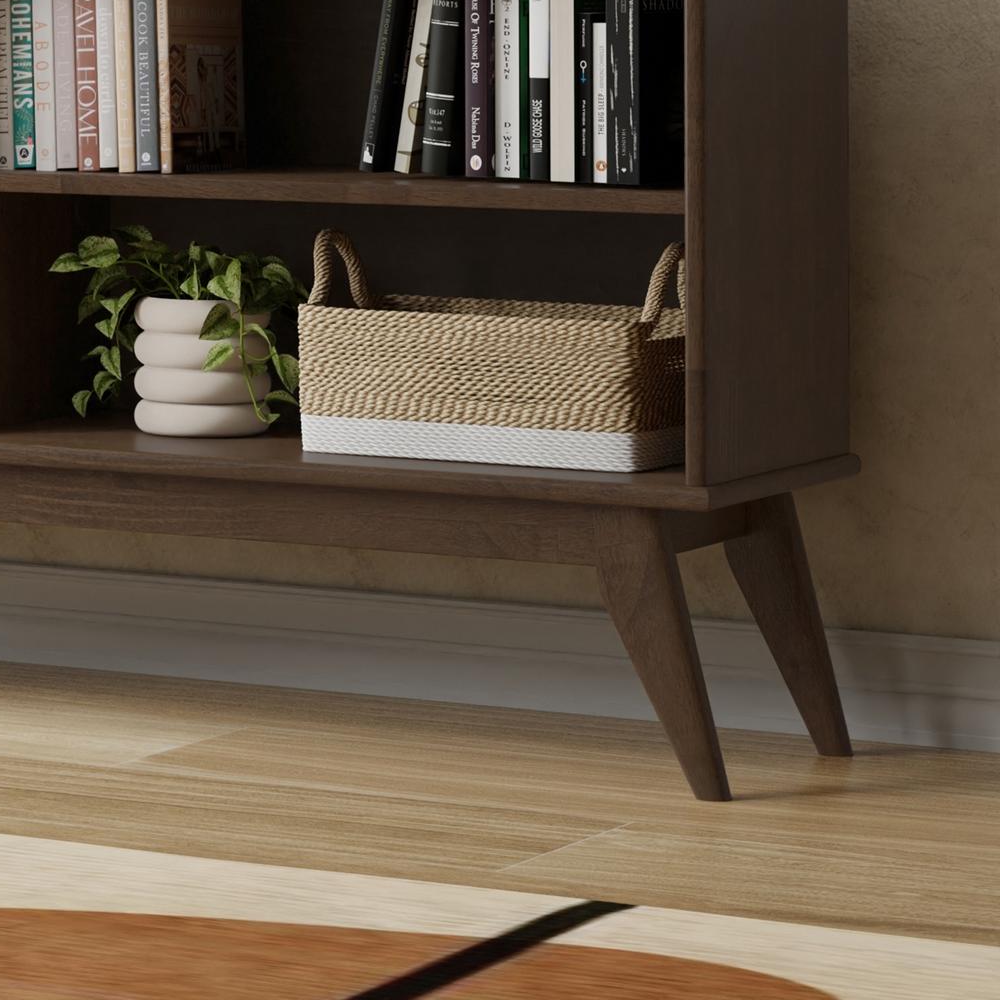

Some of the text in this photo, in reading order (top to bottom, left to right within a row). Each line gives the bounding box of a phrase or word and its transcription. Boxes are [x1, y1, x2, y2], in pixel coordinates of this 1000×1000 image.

[35, 21, 50, 113] ABODE
[77, 66, 98, 145] HOME
[137, 1, 151, 137] COOK BEAUTIFUL
[471, 106, 481, 150] Nabina Das
[532, 99, 543, 153] WILD GOOSE CHASE
